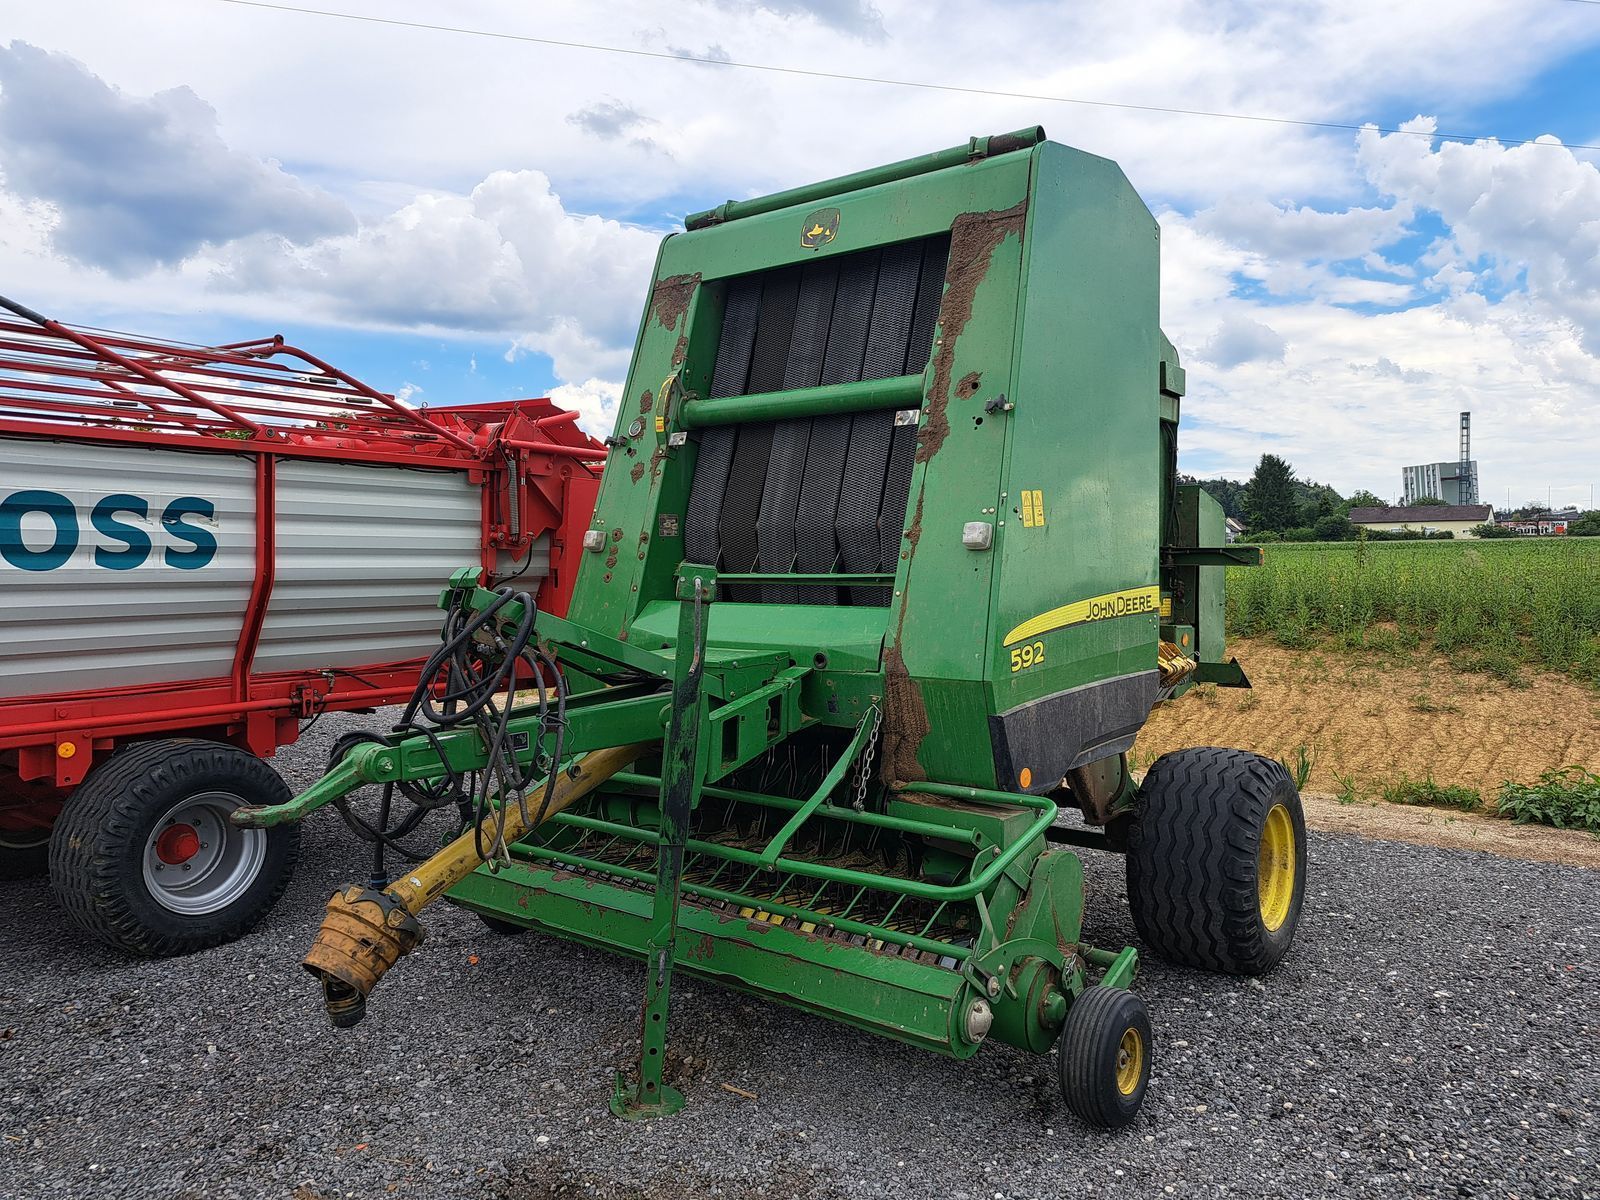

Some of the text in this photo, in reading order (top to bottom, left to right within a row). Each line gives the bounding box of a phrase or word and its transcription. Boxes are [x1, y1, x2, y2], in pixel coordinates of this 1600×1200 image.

[1085, 601, 1116, 619] JOHN
[1116, 595, 1153, 615] DEERE
[1010, 640, 1045, 673] 592
